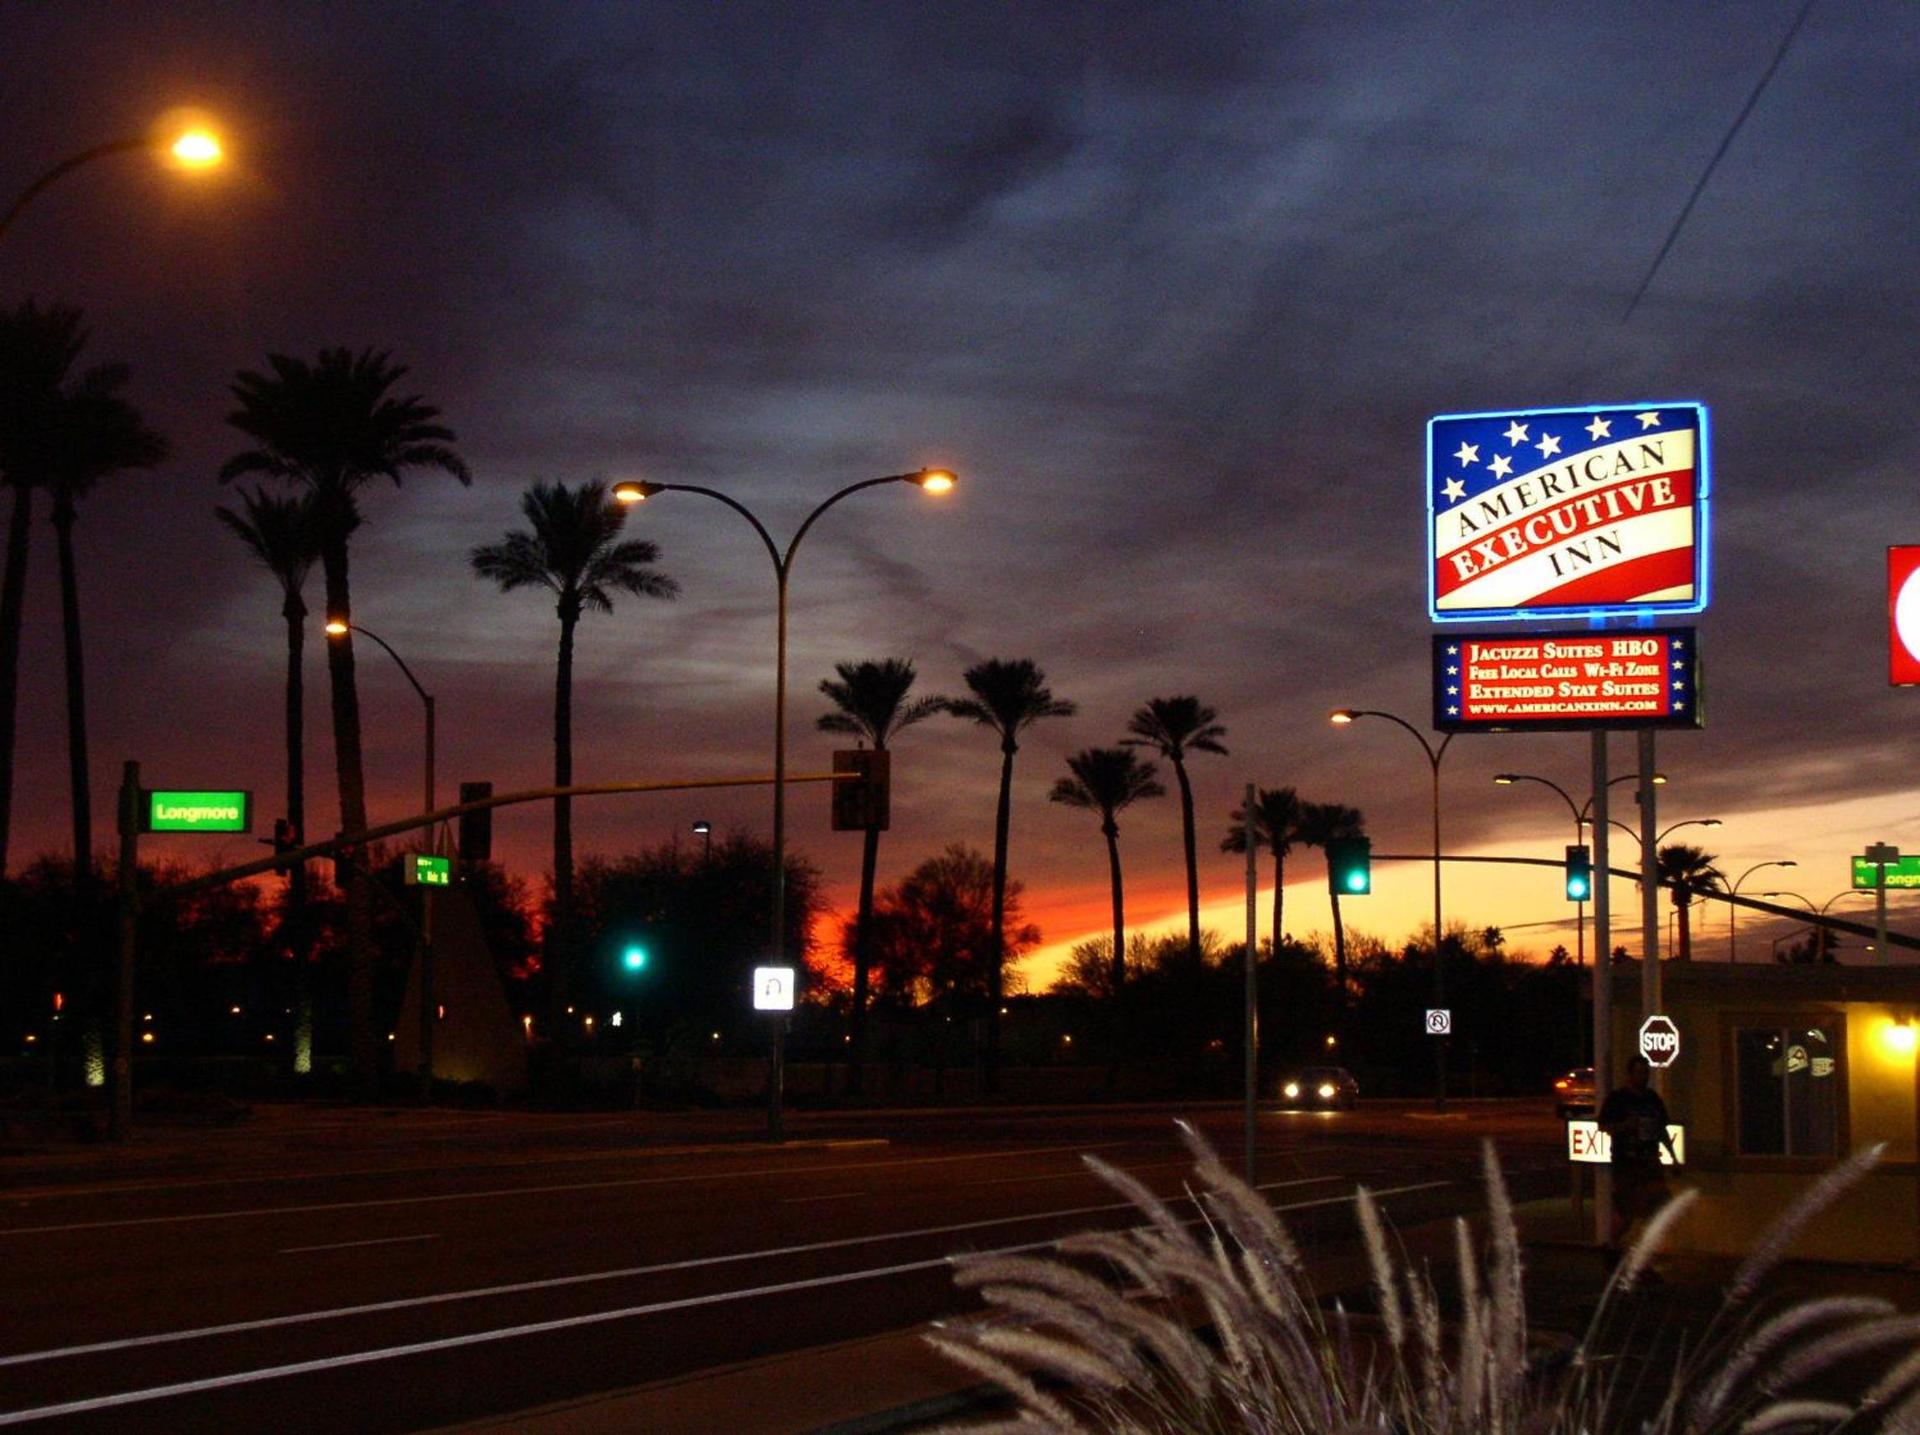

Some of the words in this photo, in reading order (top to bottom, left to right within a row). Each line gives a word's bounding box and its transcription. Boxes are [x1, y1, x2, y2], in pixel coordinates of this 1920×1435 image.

[1459, 440, 1665, 537] AMERICAN
[1450, 477, 1677, 582] EXECUTIVE
[1549, 529, 1625, 578] INN
[1470, 644, 1539, 663] JACUZZI
[1543, 642, 1604, 659] SUITES
[1612, 640, 1659, 657] HBO
[1469, 684, 1555, 699] EXTENDED
[1558, 682, 1598, 697] STAY
[1601, 680, 1660, 696] SUITES
[156, 804, 239, 823] Longmore
[1644, 1032, 1675, 1051] STOP
